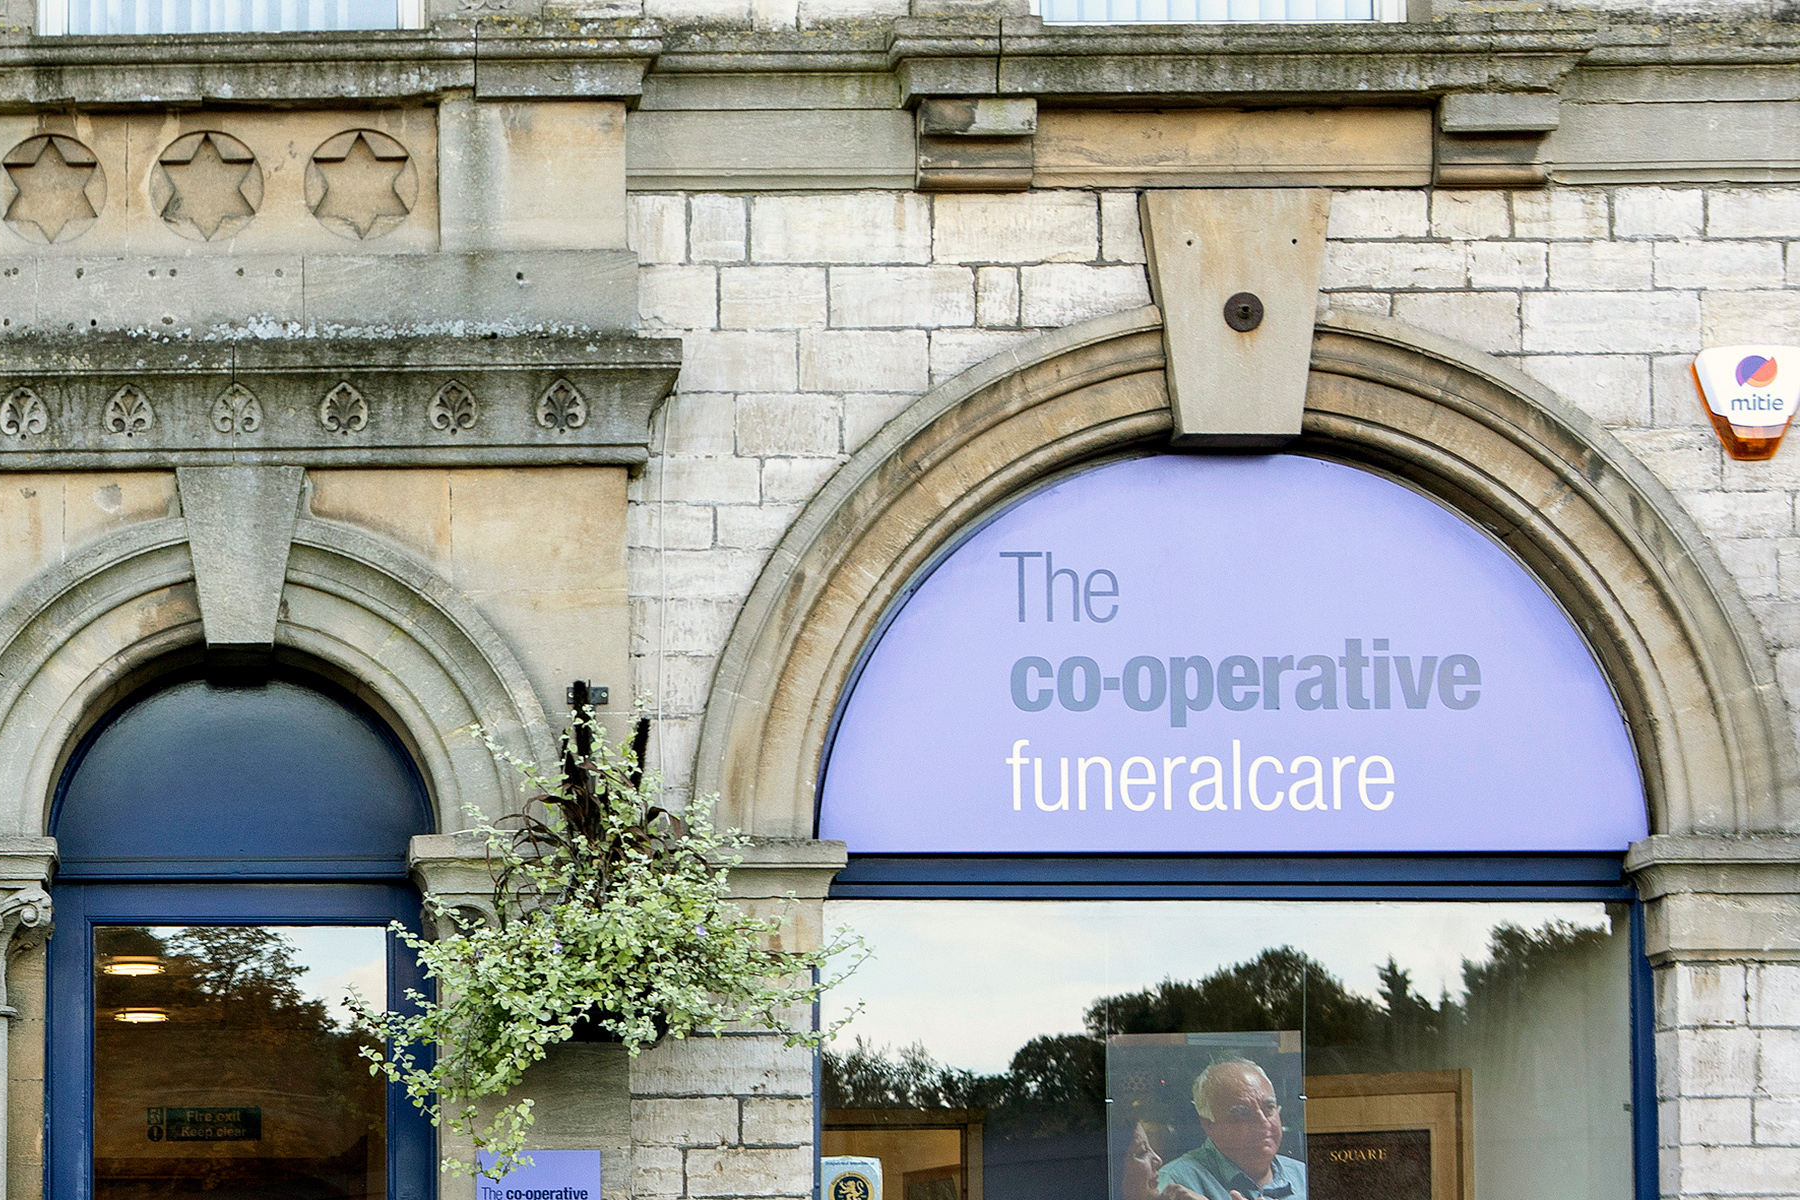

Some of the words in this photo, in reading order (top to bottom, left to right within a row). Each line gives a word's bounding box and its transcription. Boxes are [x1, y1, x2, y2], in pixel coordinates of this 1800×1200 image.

[1731, 393, 1784, 411] mitie
[1000, 551, 1120, 623] The
[1010, 638, 1482, 728] co-operative
[1006, 739, 1395, 812] funeralcare
[186, 1110, 212, 1122] Fire
[216, 1110, 241, 1122] exit
[181, 1127, 212, 1139] Keep
[216, 1127, 246, 1137] clear
[1330, 1148, 1387, 1161] SQUARE
[481, 1186, 503, 1200] The
